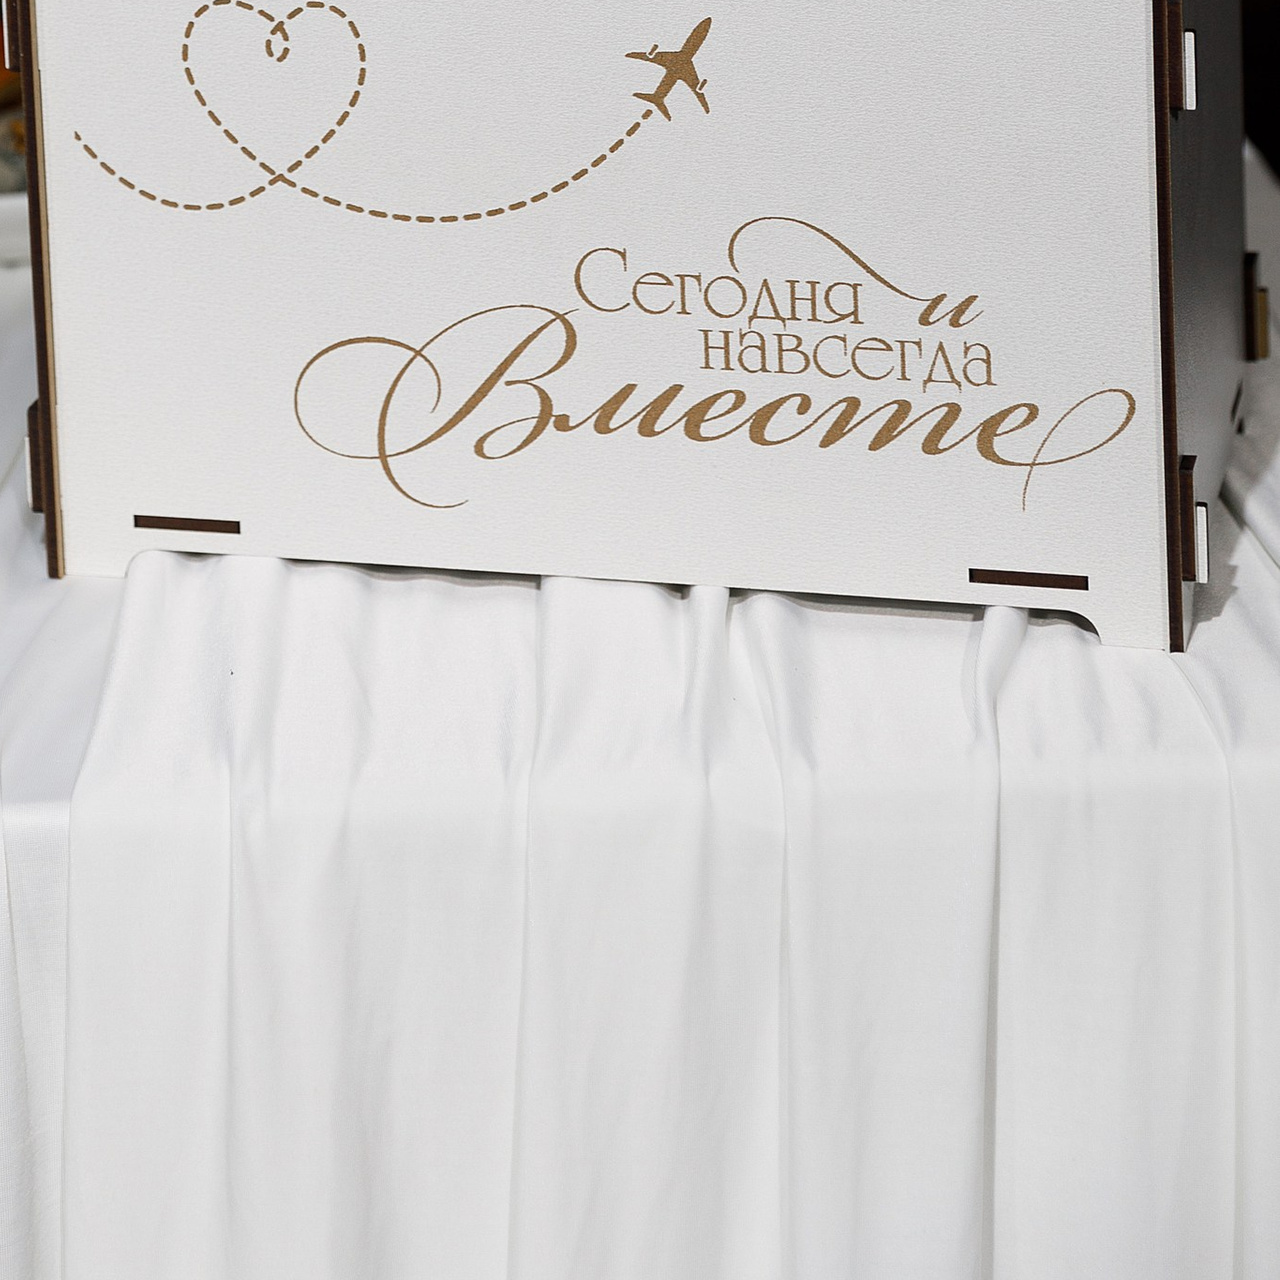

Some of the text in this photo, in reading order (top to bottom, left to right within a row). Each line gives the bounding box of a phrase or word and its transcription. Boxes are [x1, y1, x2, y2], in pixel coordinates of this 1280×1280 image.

[573, 246, 865, 326] Сегодня
[699, 326, 999, 393] навсегда
[293, 303, 1137, 513] Вместе
